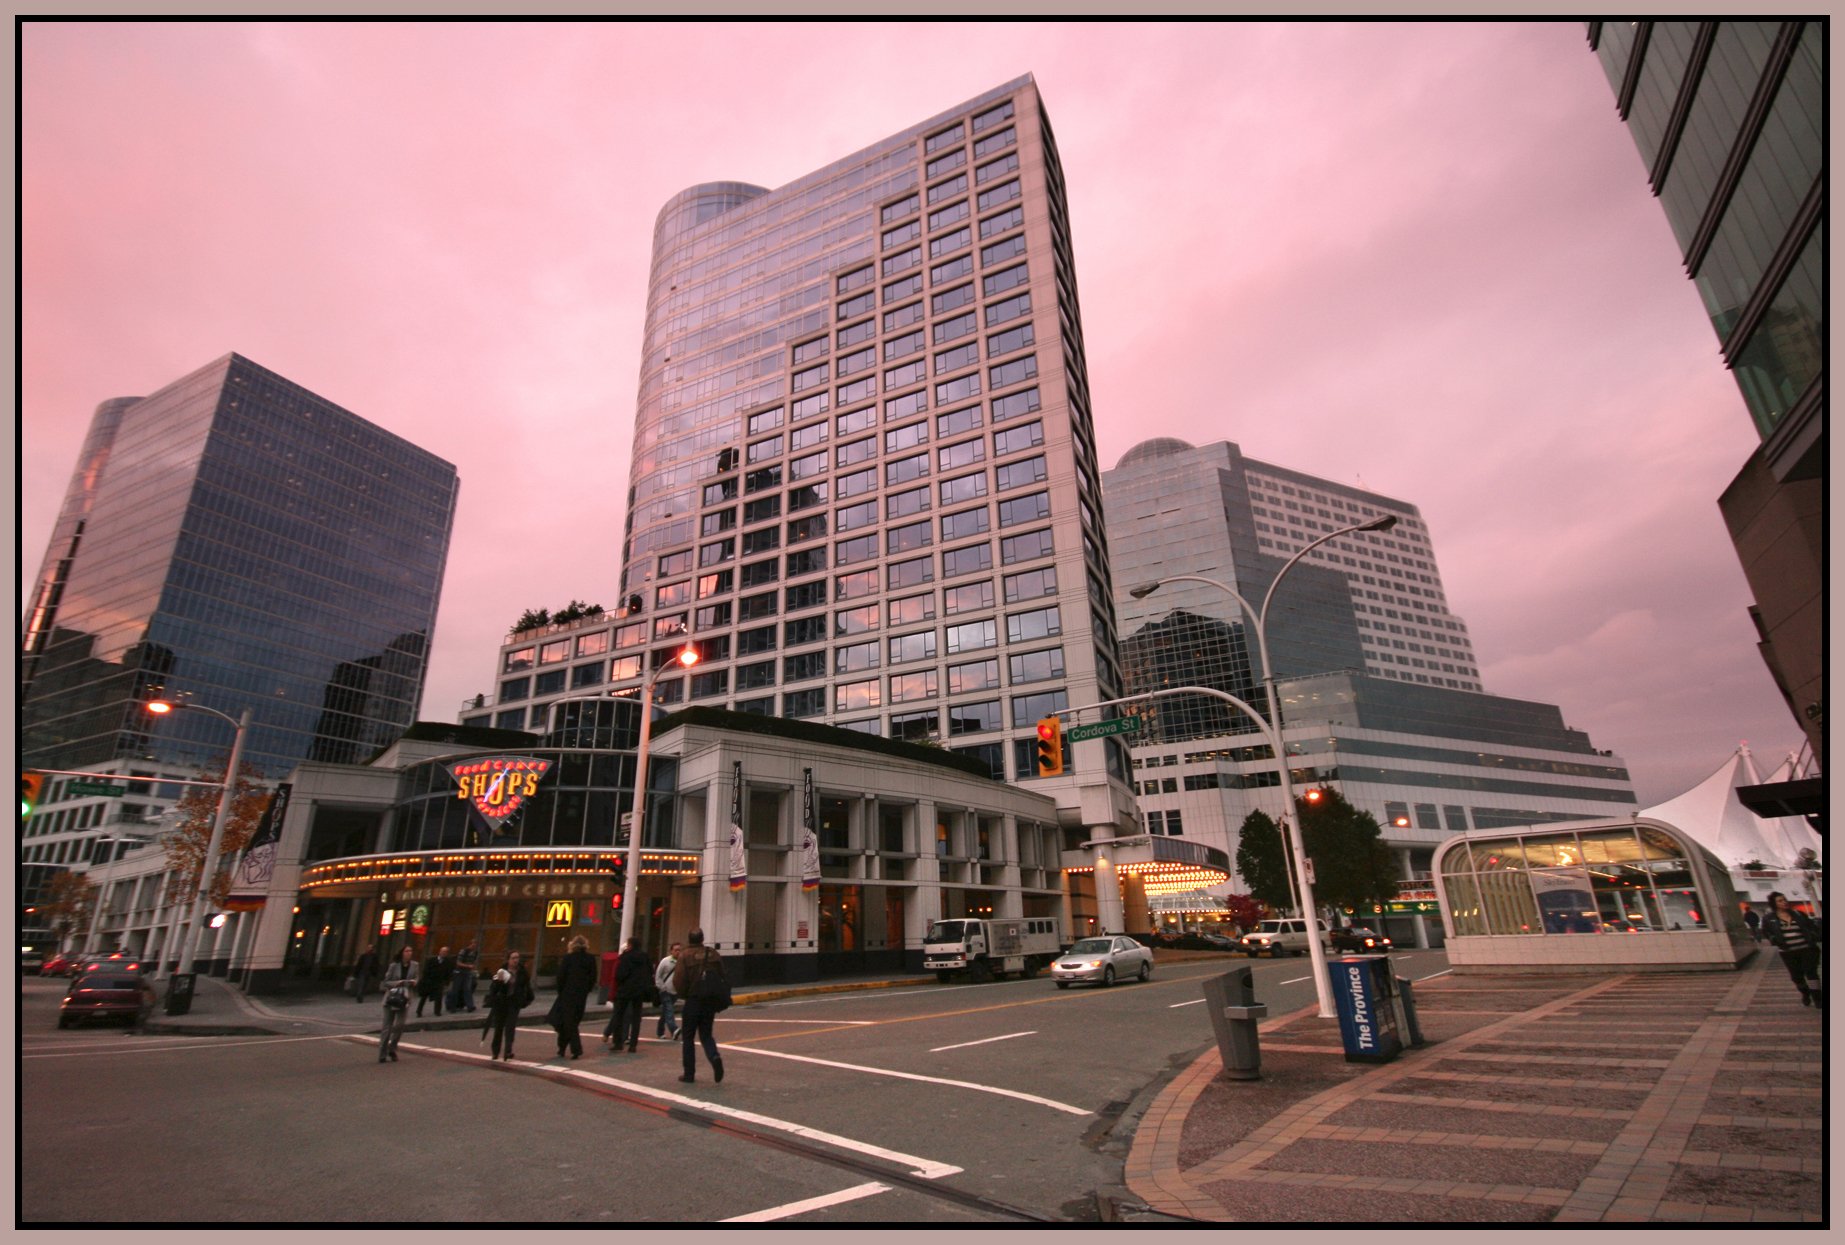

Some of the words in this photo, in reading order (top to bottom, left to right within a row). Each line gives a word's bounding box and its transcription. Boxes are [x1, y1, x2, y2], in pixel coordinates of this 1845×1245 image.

[1072, 723, 1117, 739] Cordova
[1121, 719, 1135, 730] St
[458, 772, 538, 805] SHOPS
[268, 788, 286, 840] SHOPS
[522, 882, 605, 896] CENTRE
[1349, 967, 1369, 1023] Province
[1359, 1025, 1373, 1049] The
